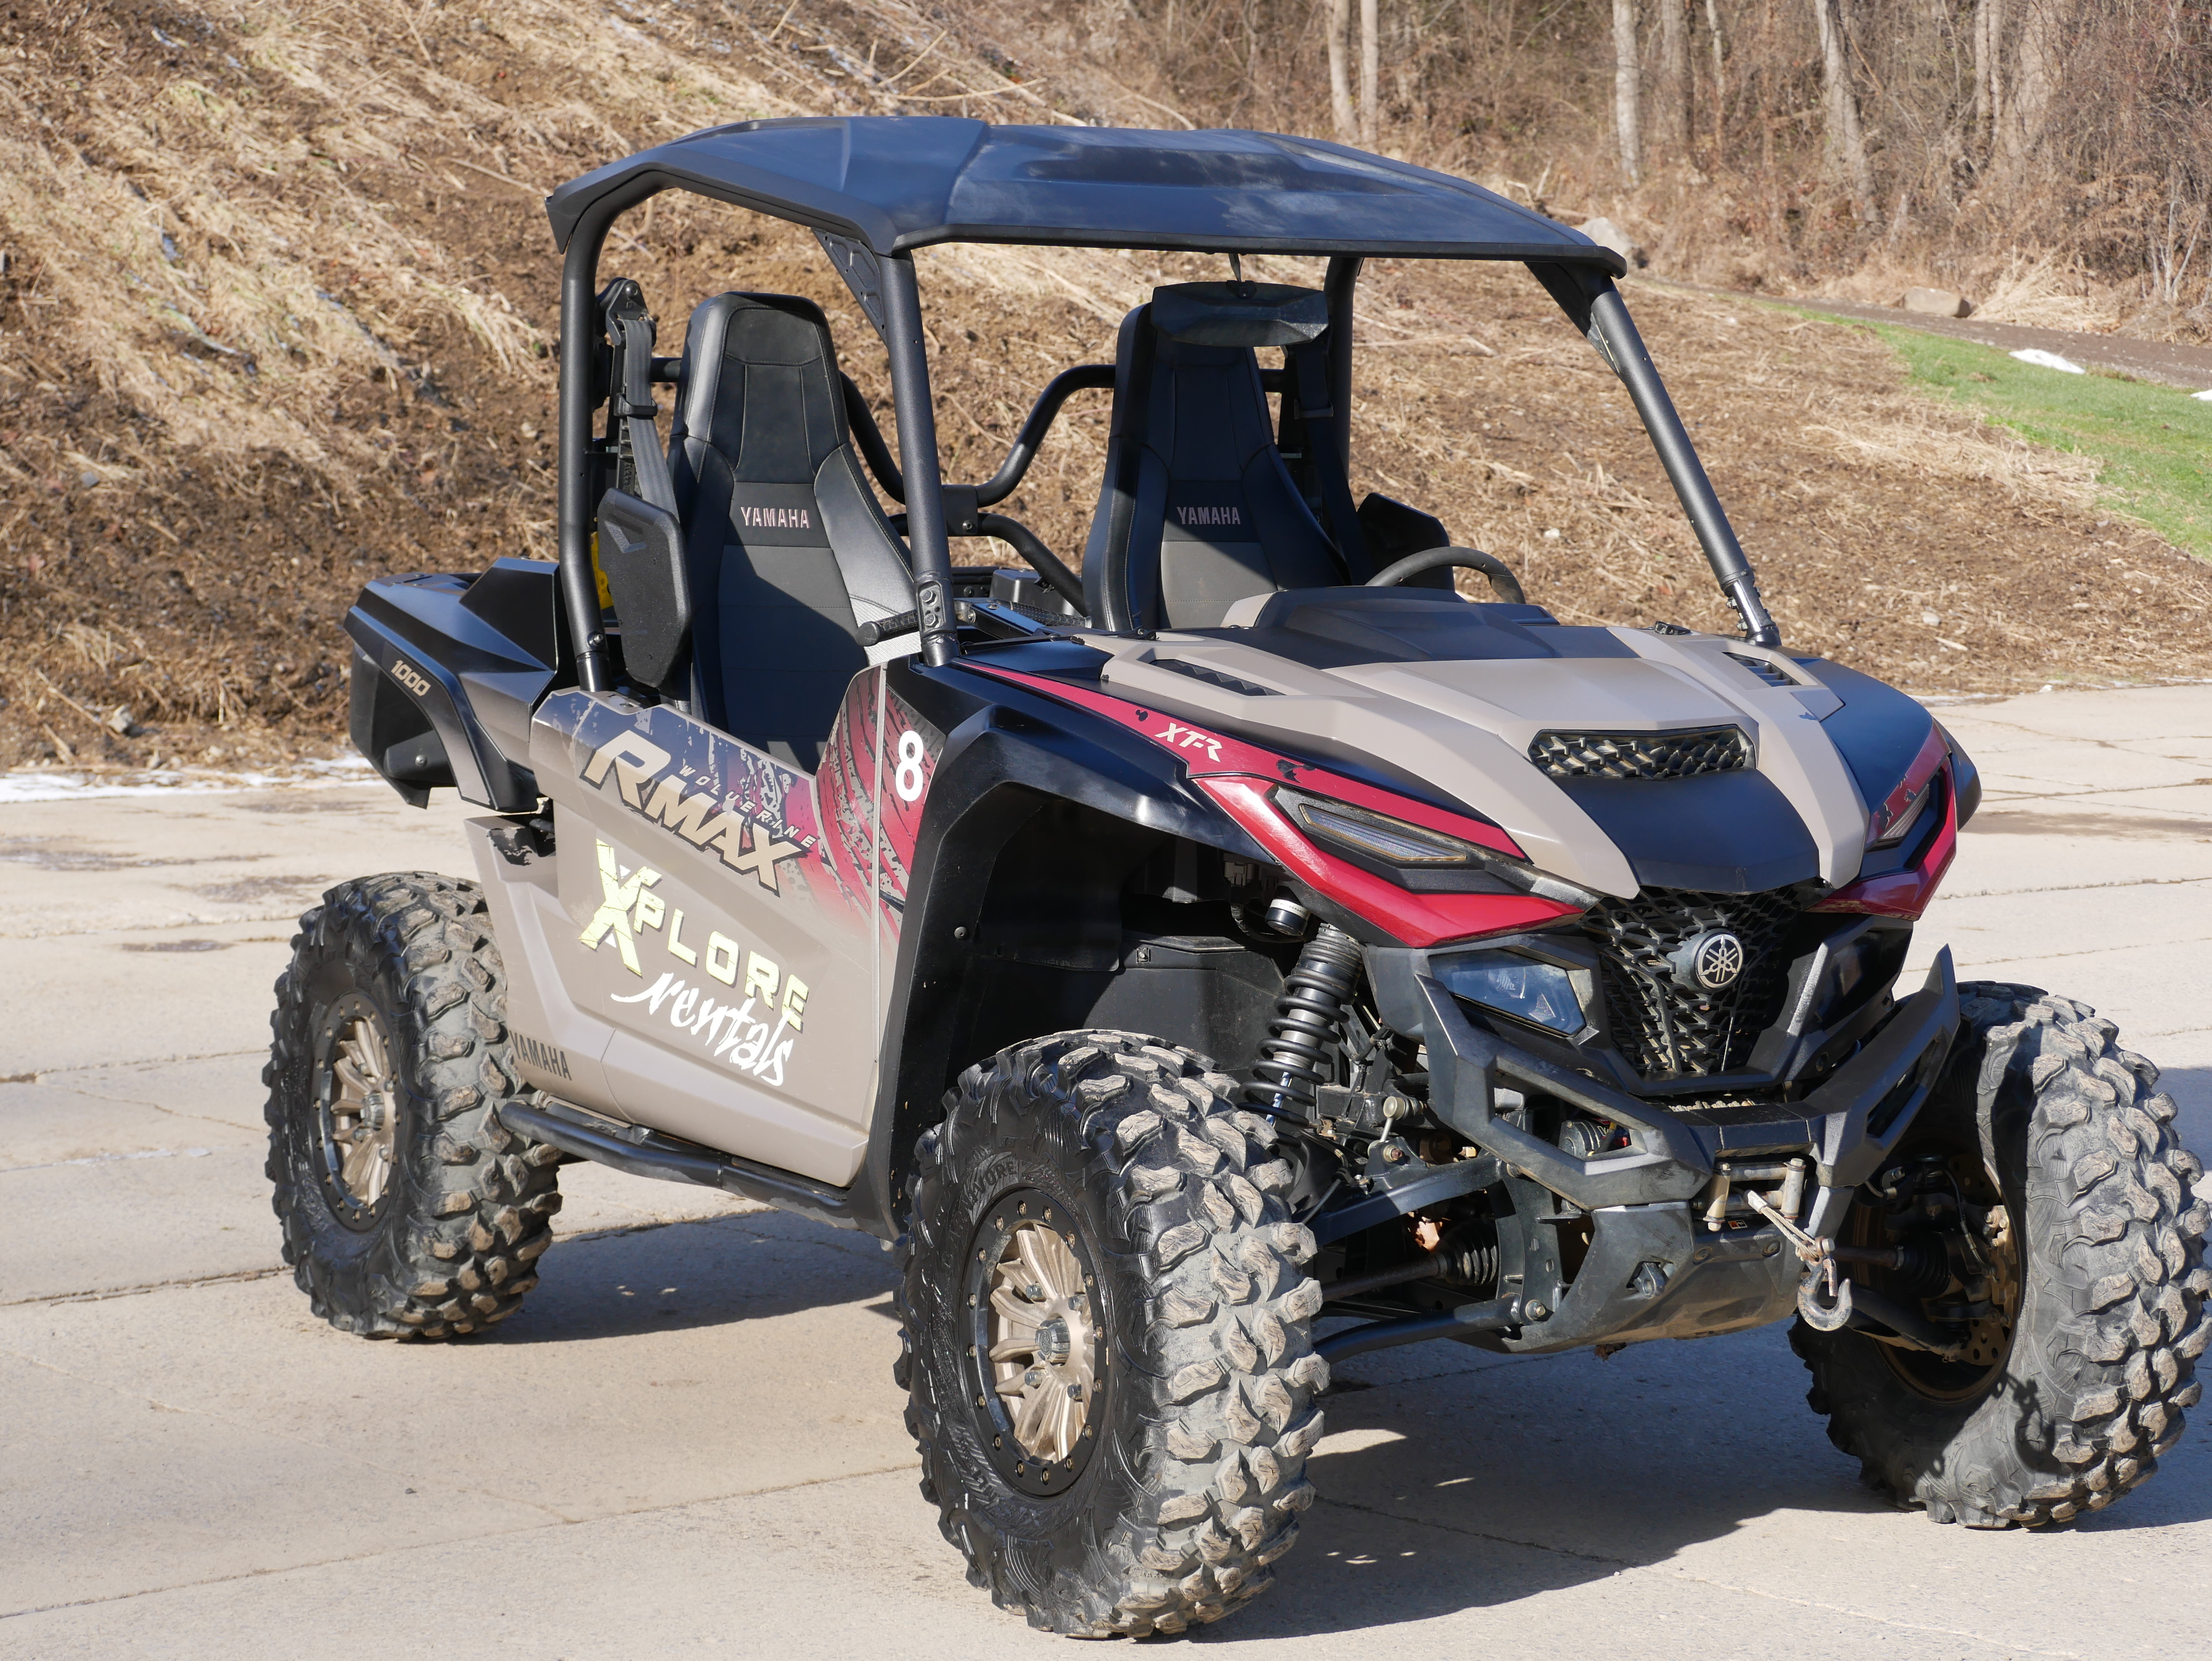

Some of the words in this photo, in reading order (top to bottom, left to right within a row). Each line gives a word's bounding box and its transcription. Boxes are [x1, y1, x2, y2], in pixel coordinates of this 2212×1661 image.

[740, 507, 810, 529] YAMAHA
[1177, 507, 1241, 525] YAMAHA
[391, 659, 431, 697] 1000
[1154, 722, 1223, 763] XT-R
[895, 730, 924, 802] 8
[581, 729, 810, 894] RMAX
[578, 838, 809, 1032] XPLORE
[509, 1030, 572, 1081] YAMAHA
